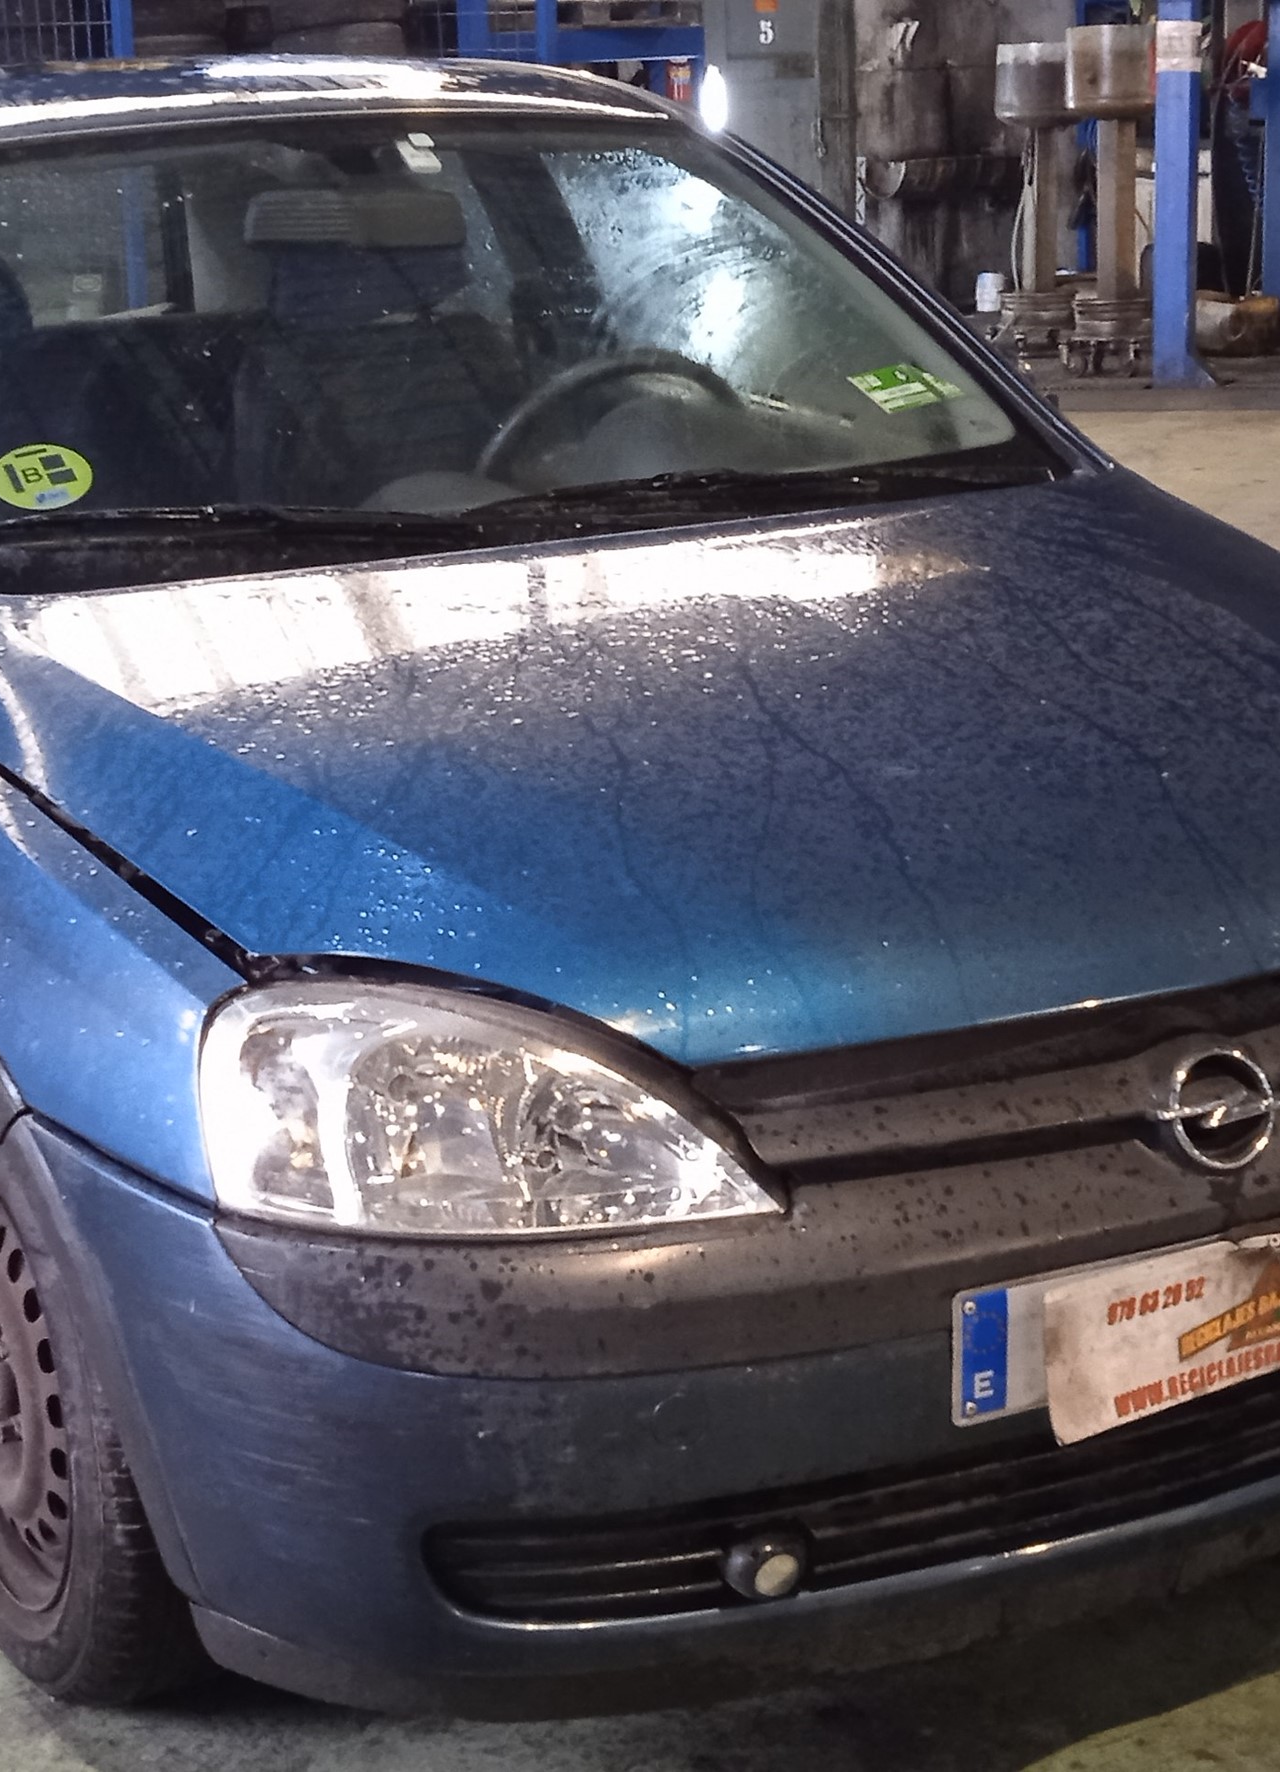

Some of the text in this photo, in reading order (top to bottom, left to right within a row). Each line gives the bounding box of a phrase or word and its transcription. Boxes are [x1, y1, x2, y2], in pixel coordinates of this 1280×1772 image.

[759, 19, 775, 45] 5
[21, 467, 43, 484] B
[974, 1369, 995, 1399] E
